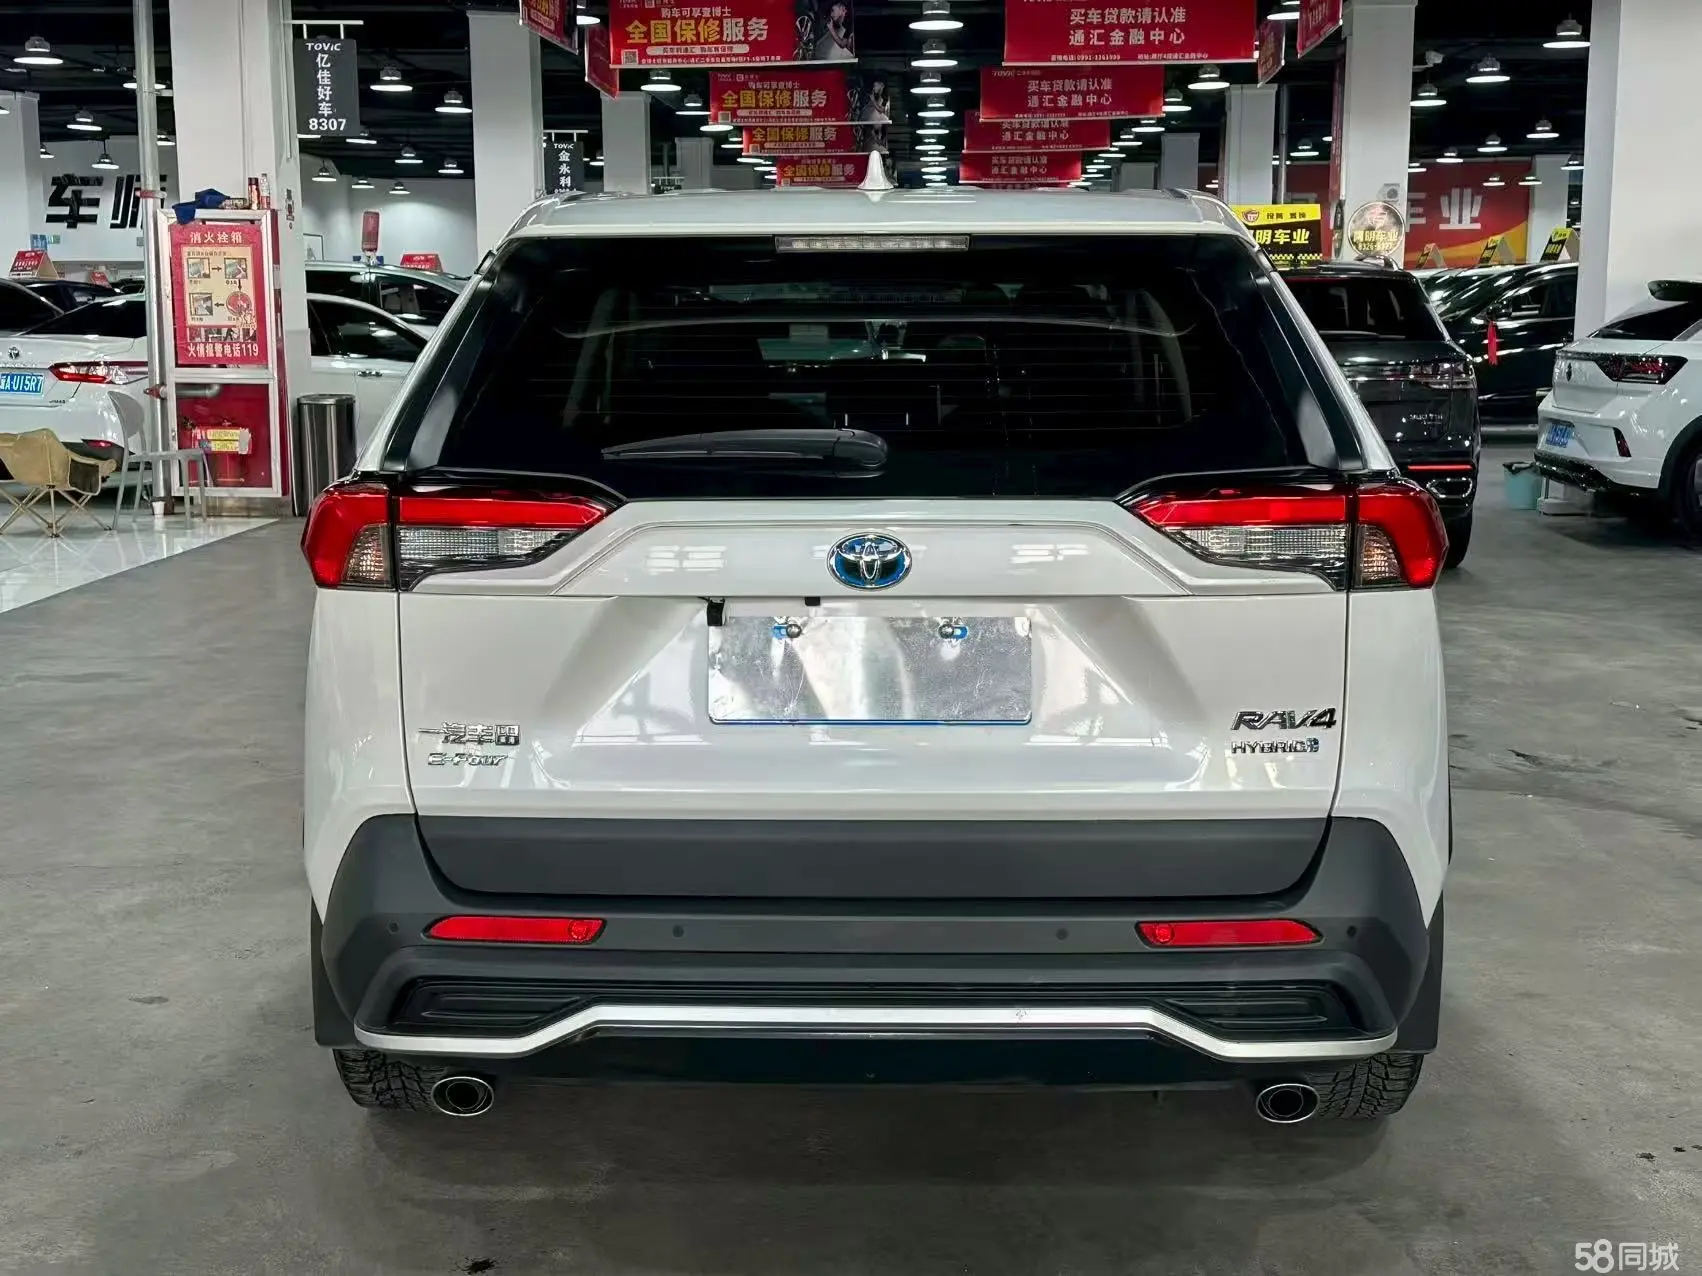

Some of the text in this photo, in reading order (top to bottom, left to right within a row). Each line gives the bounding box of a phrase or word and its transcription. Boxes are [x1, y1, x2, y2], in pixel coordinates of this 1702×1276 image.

[1069, 7, 1186, 25] 买车贷款请认准
[626, 17, 769, 44] 全国保修服务
[1069, 28, 1185, 46] 通汇金融中心
[316, 53, 333, 117] 亿佳好车
[1027, 78, 1112, 93] 买车贷款请认准
[722, 90, 827, 108] 全国保修服务
[1027, 93, 1112, 108] 通汇金融中心
[309, 118, 347, 131] 8307
[752, 127, 837, 142] 全国保修服务
[190, 231, 242, 244] 消火栓箱
[188, 342, 259, 358] 火情报警电话119
[1231, 707, 1337, 730] RAV4
[418, 721, 521, 746] 一汽丰田
[427, 752, 508, 767] E-Four
